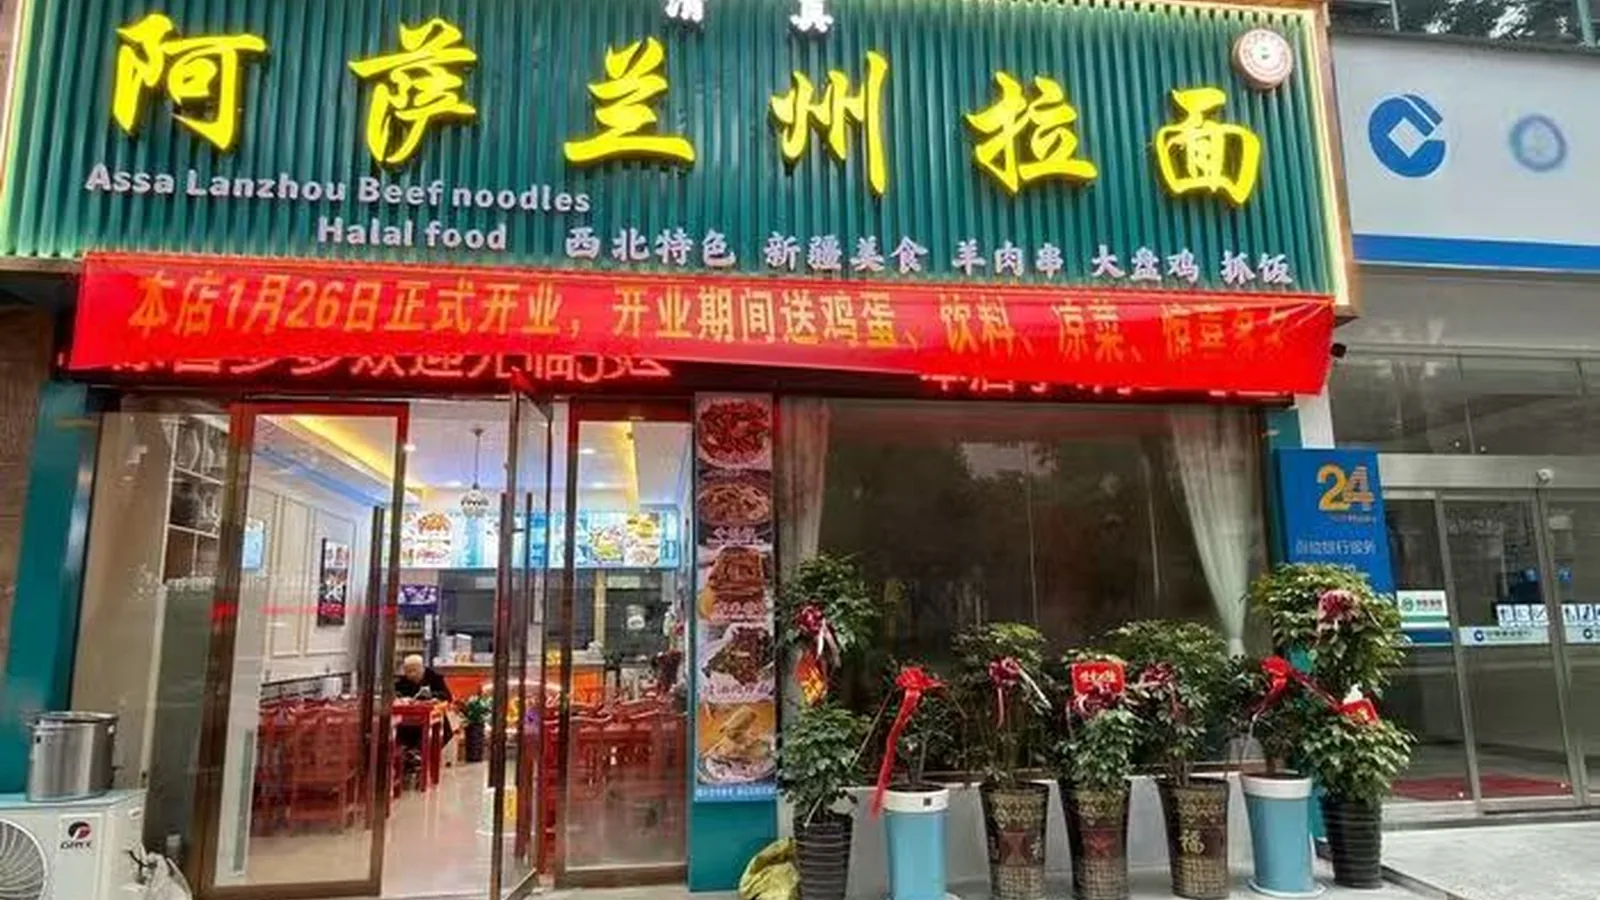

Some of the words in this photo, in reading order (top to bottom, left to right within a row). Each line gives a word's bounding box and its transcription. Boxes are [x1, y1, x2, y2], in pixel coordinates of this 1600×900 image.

[112, 14, 1261, 206] 阿萨兰州拉面
[85, 163, 174, 193] Assa
[186, 169, 346, 201] Lanzhou
[358, 177, 443, 205] Beef
[453, 185, 590, 213] noodles
[318, 217, 413, 246] Halal
[425, 221, 507, 250] food
[565, 227, 737, 268] 西北特色
[763, 231, 929, 274] 新疆美食
[952, 239, 1064, 278] 羊肉串
[1091, 245, 1199, 284] 大盘鸡
[1220, 249, 1293, 285] 抓饭
[1317, 464, 1375, 511] 24
